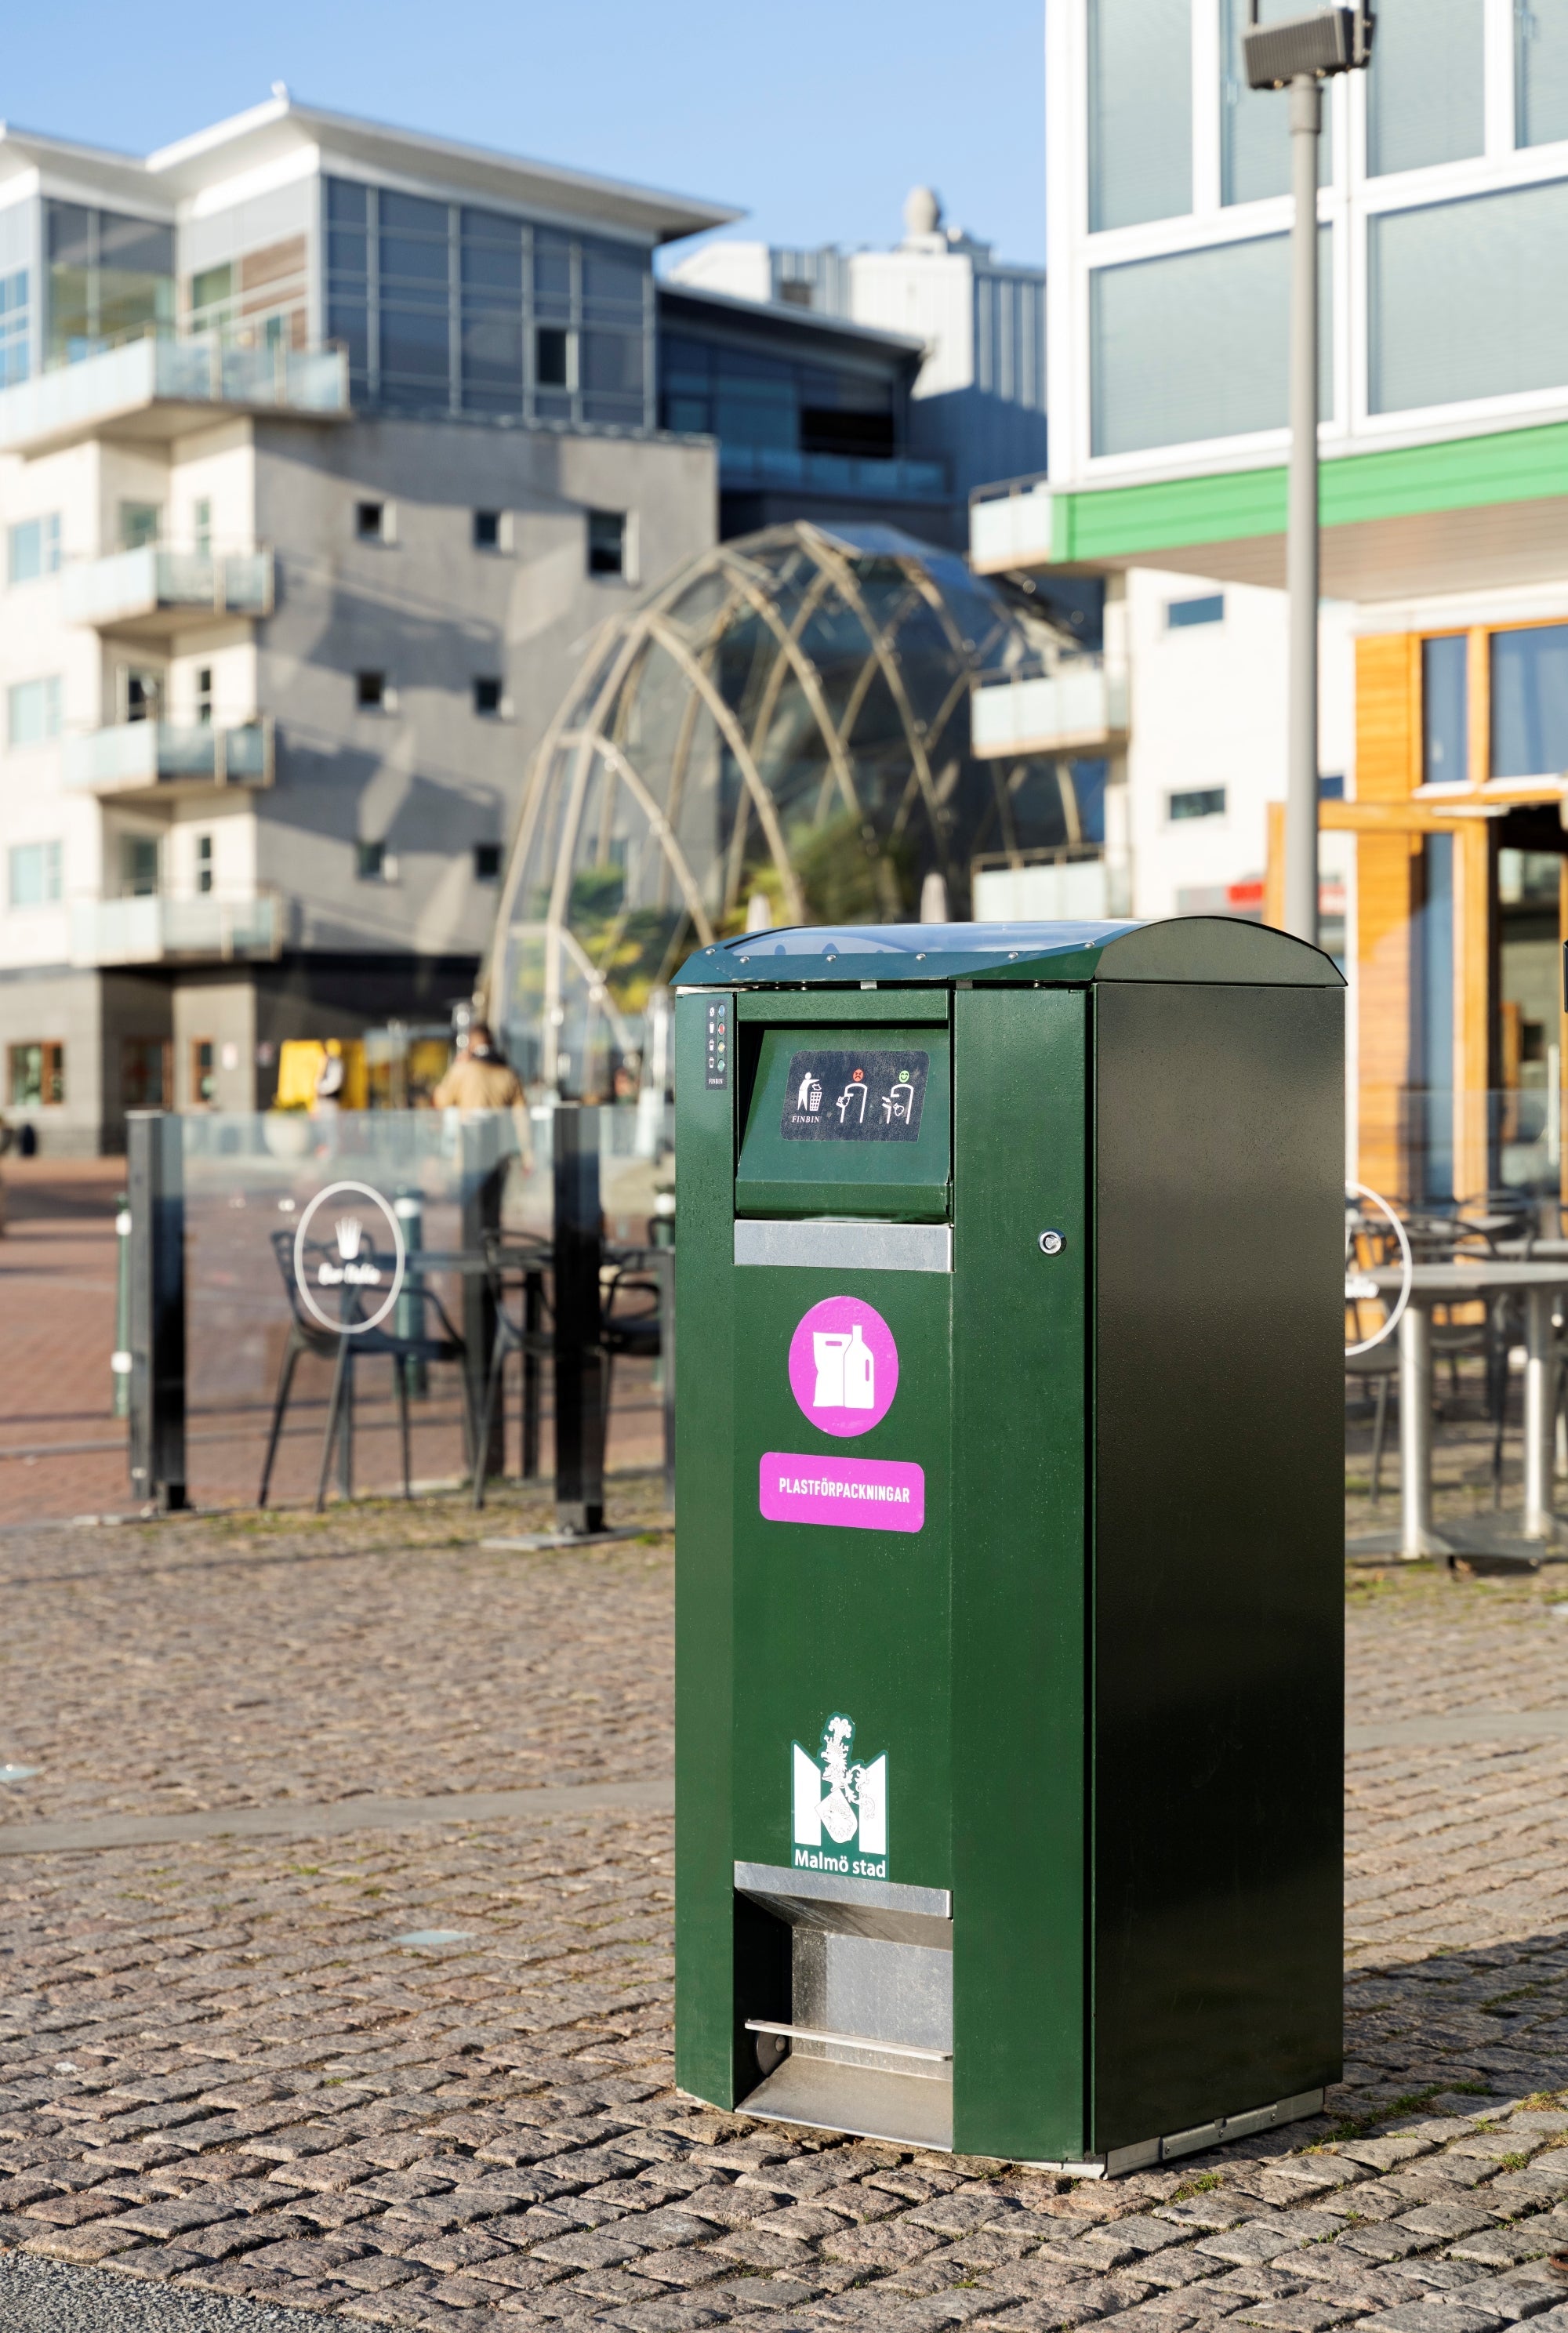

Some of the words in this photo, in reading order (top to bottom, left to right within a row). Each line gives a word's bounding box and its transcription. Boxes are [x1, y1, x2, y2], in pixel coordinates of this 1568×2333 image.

[779, 1478, 910, 1503] PLASTFÖRPACKNINGAR
[794, 1849, 849, 1873] Malmö
[852, 1860, 886, 1878] stad
